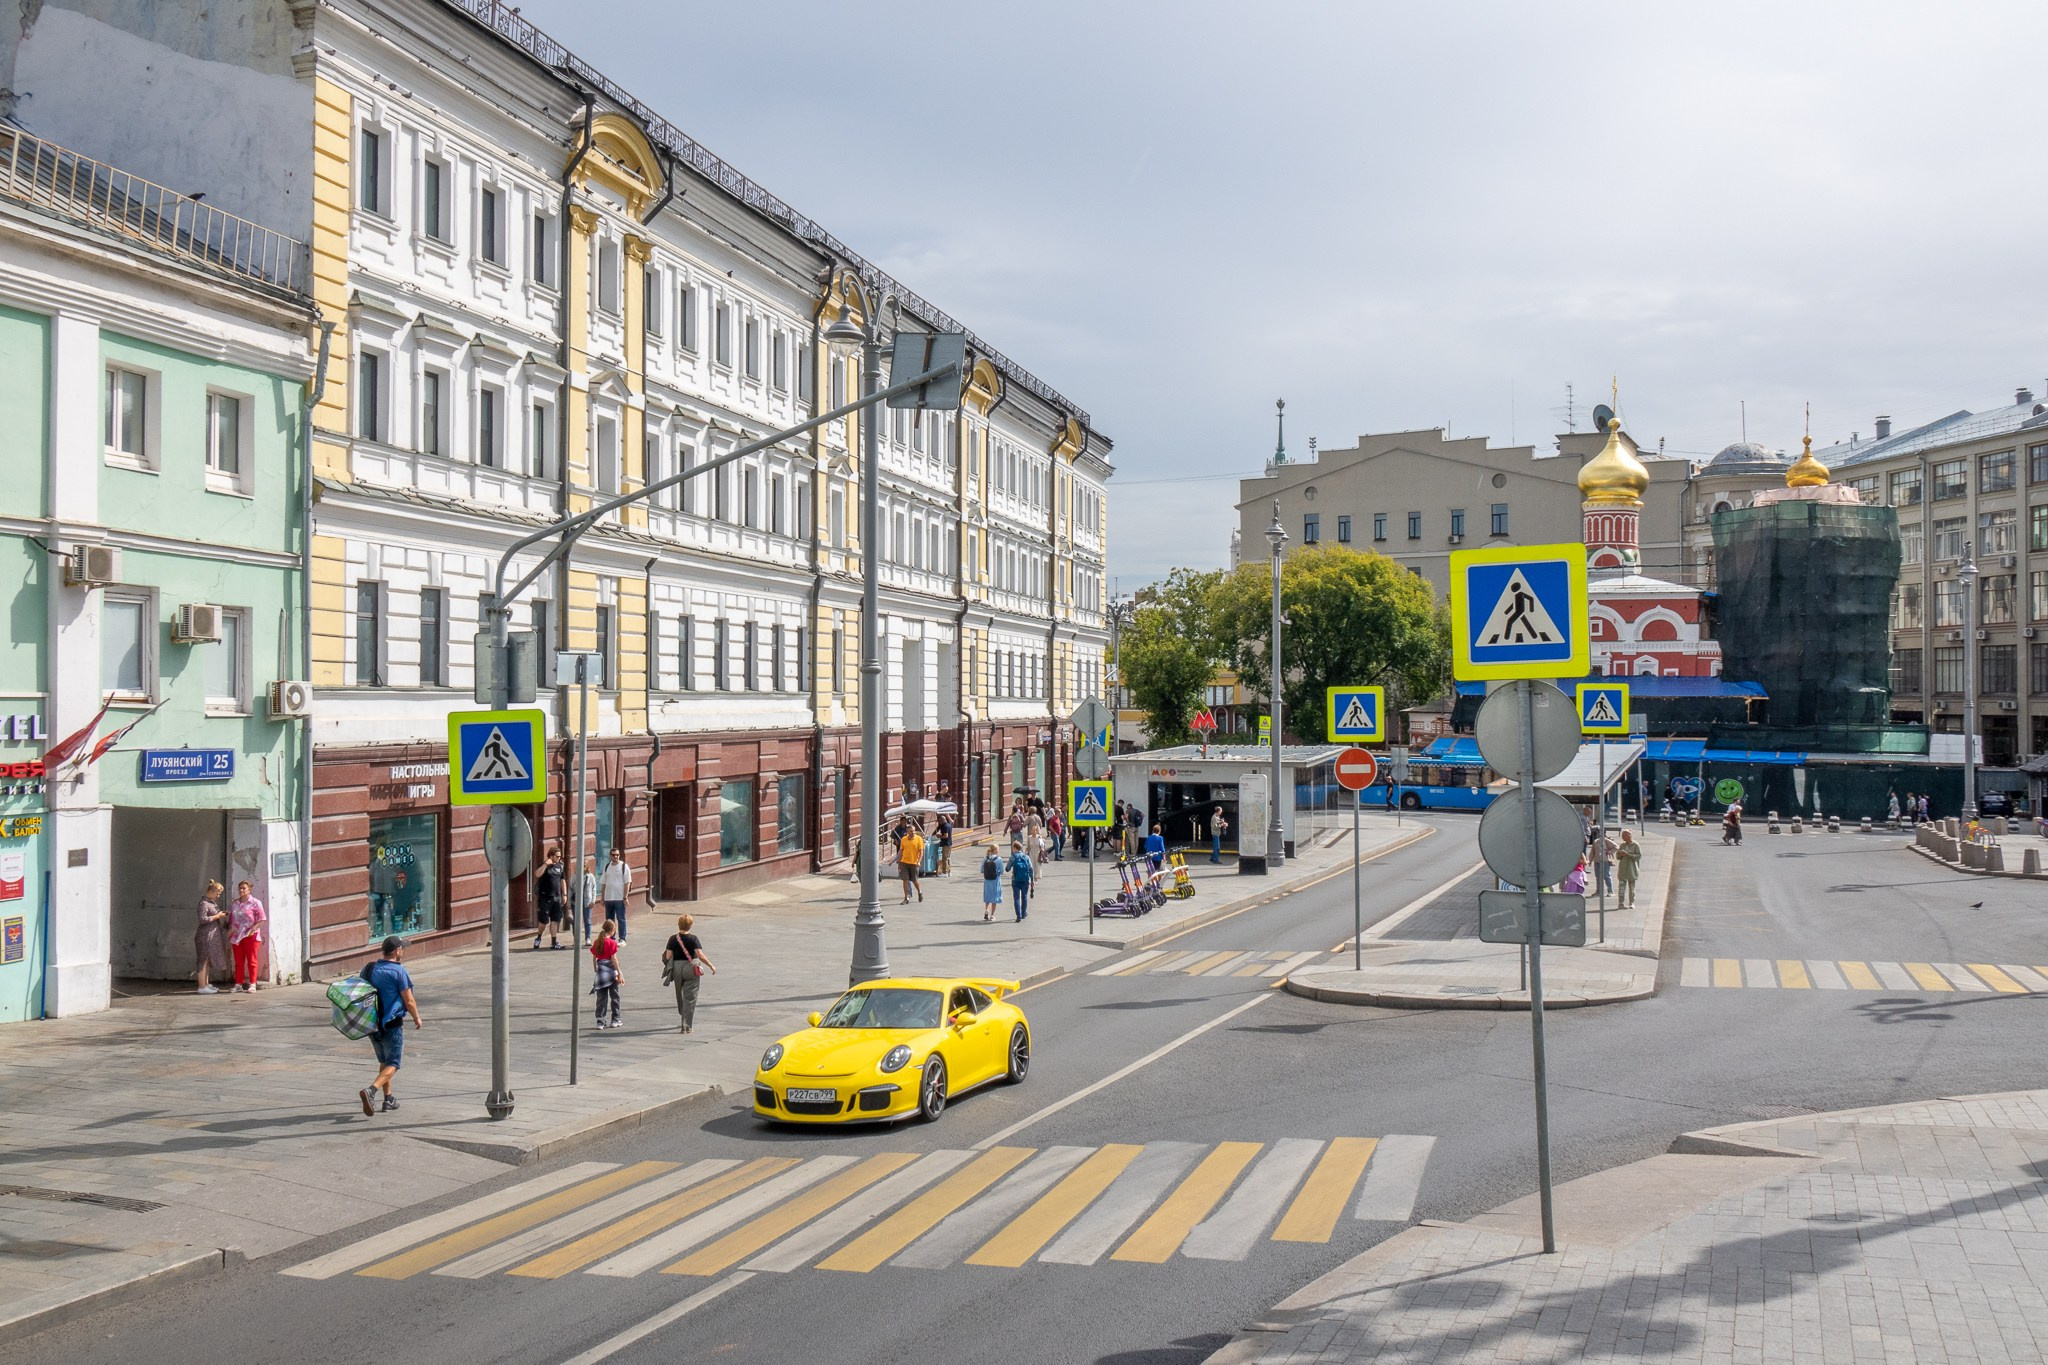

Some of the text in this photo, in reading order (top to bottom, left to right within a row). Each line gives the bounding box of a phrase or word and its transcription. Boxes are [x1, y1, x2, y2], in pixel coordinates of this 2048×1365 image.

[151, 754, 203, 768] ЛУБЯНСКИЙ
[213, 754, 229, 769] 25
[391, 763, 450, 778] НАСТОЛЬНЫ
[409, 784, 435, 798] ИГРЫ
[14, 816, 43, 826] ОБМЕН
[14, 826, 41, 837] ВАЛЮТ
[378, 846, 411, 857] HOBBY
[382, 855, 414, 866] GAMES
